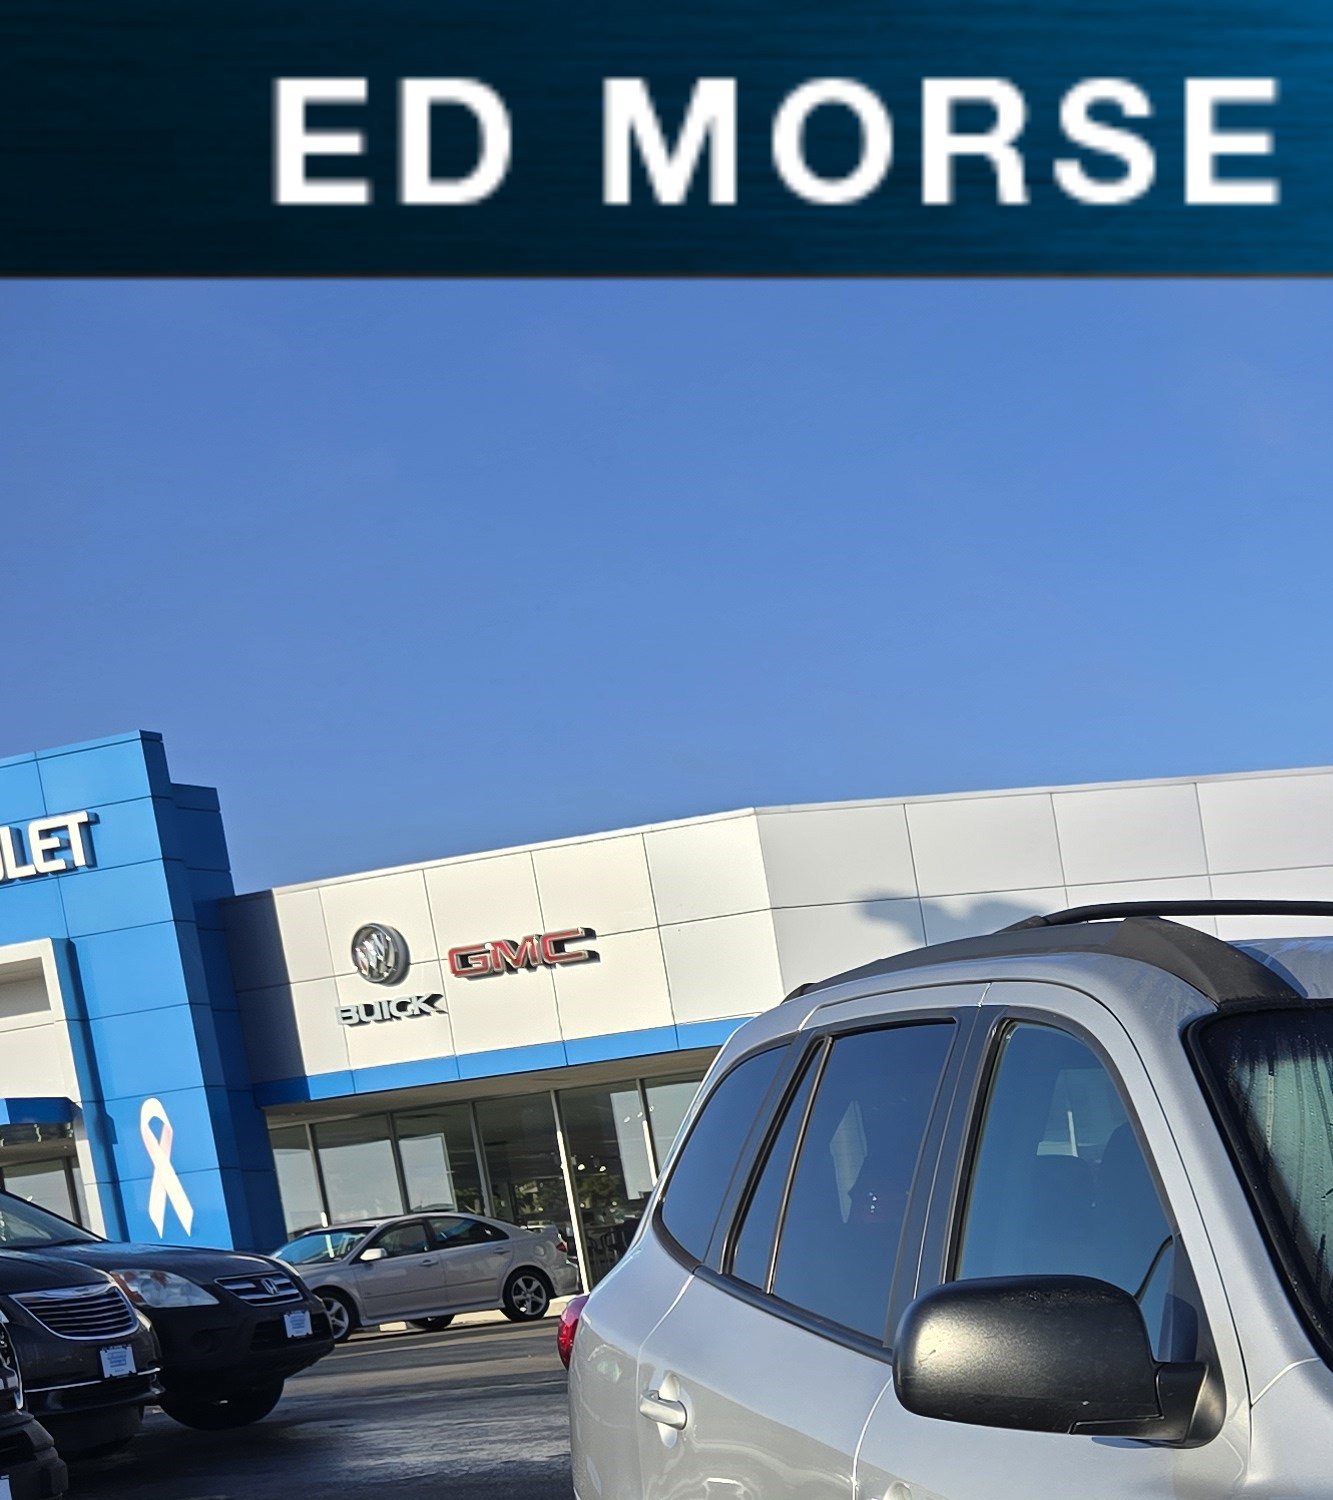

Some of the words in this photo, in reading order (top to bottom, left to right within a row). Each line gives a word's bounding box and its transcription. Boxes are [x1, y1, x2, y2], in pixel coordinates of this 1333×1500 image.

[0, 809, 90, 882] LET
[447, 926, 591, 978] GMC
[335, 993, 444, 1026] BUICK
